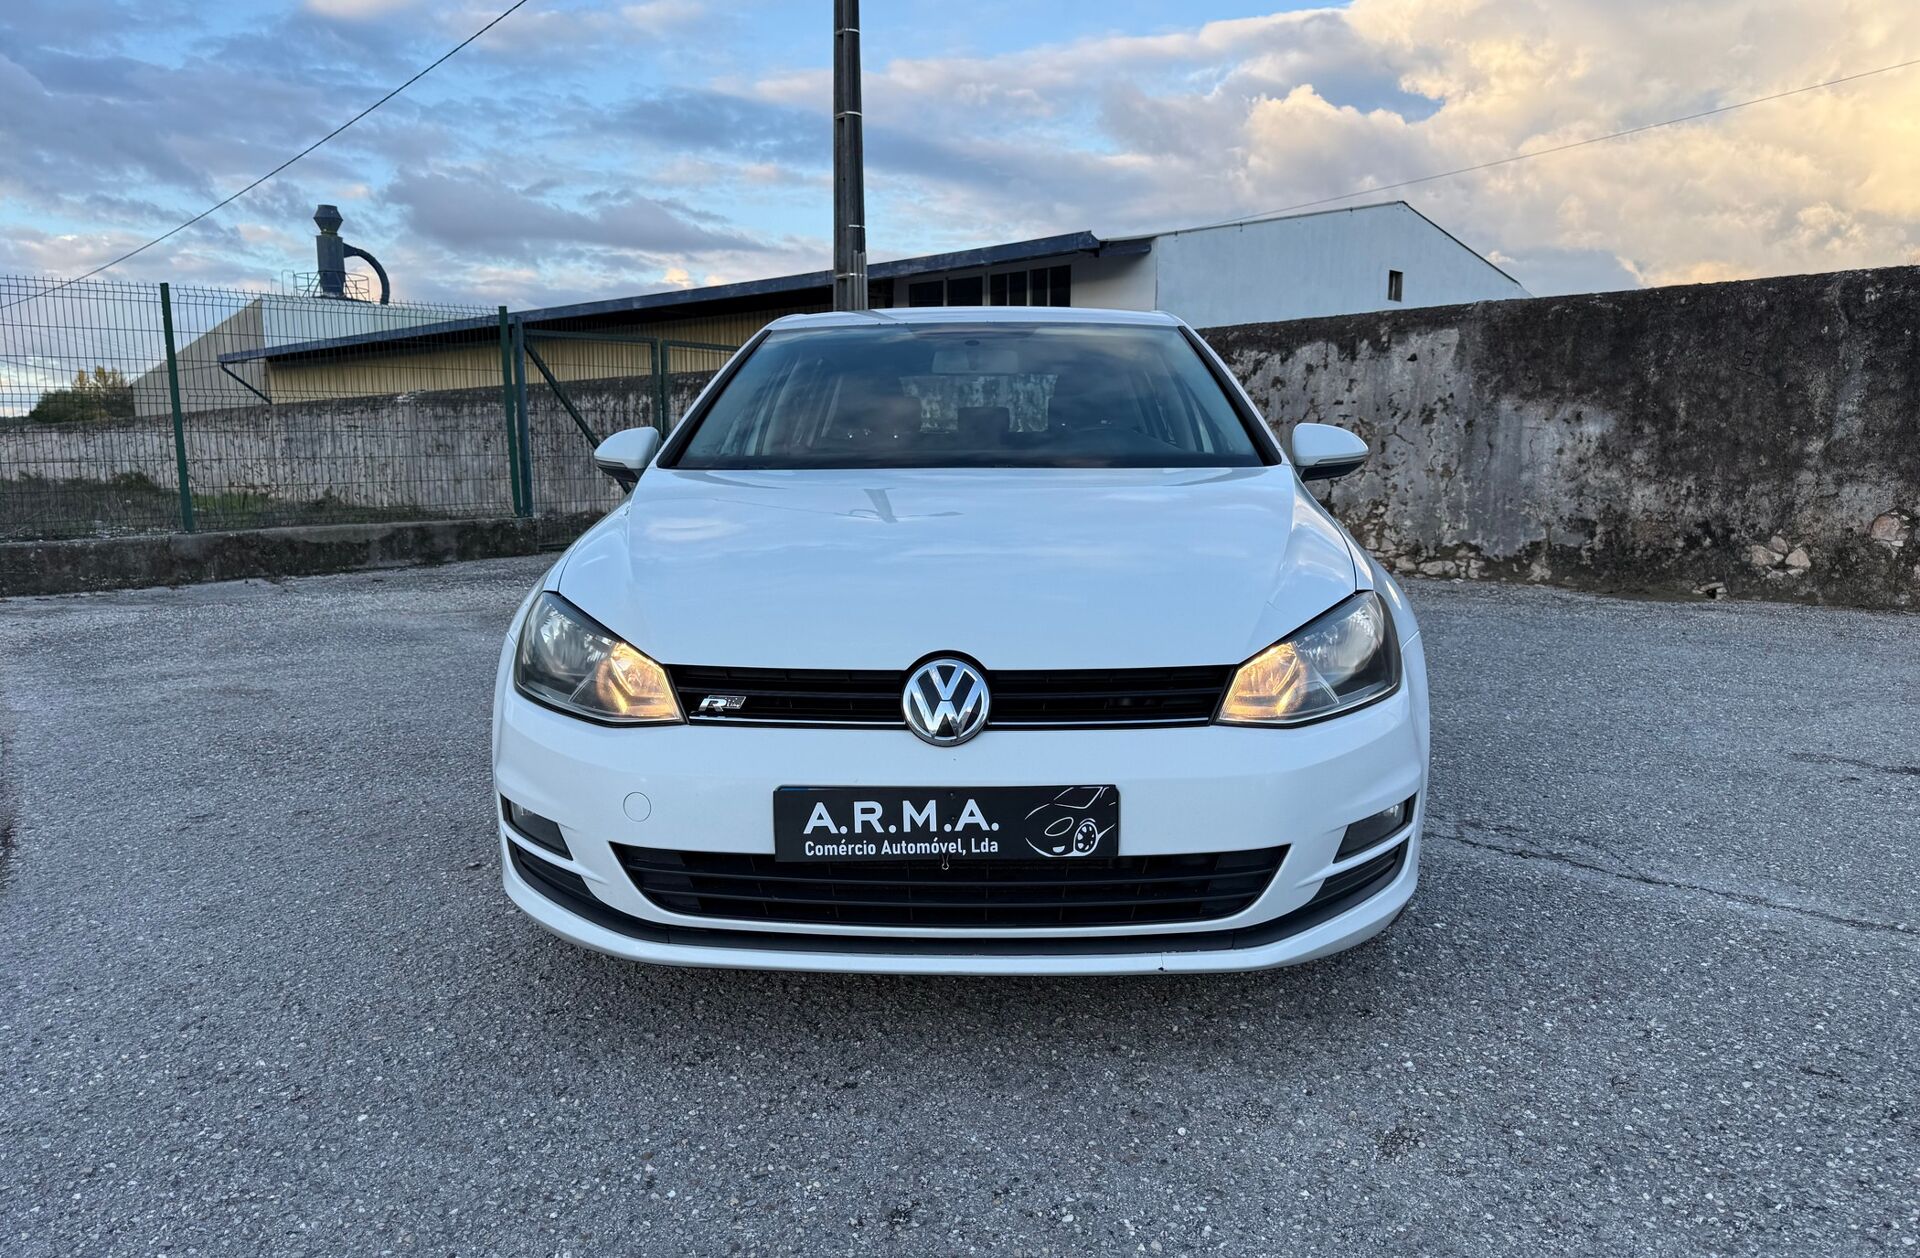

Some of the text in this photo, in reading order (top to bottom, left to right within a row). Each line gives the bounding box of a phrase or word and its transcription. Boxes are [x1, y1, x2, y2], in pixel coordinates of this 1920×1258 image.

[905, 661, 988, 744] VW
[803, 799, 999, 834] A.R.M.A.
[805, 837, 999, 856] Comércio Automóvel, Lda
